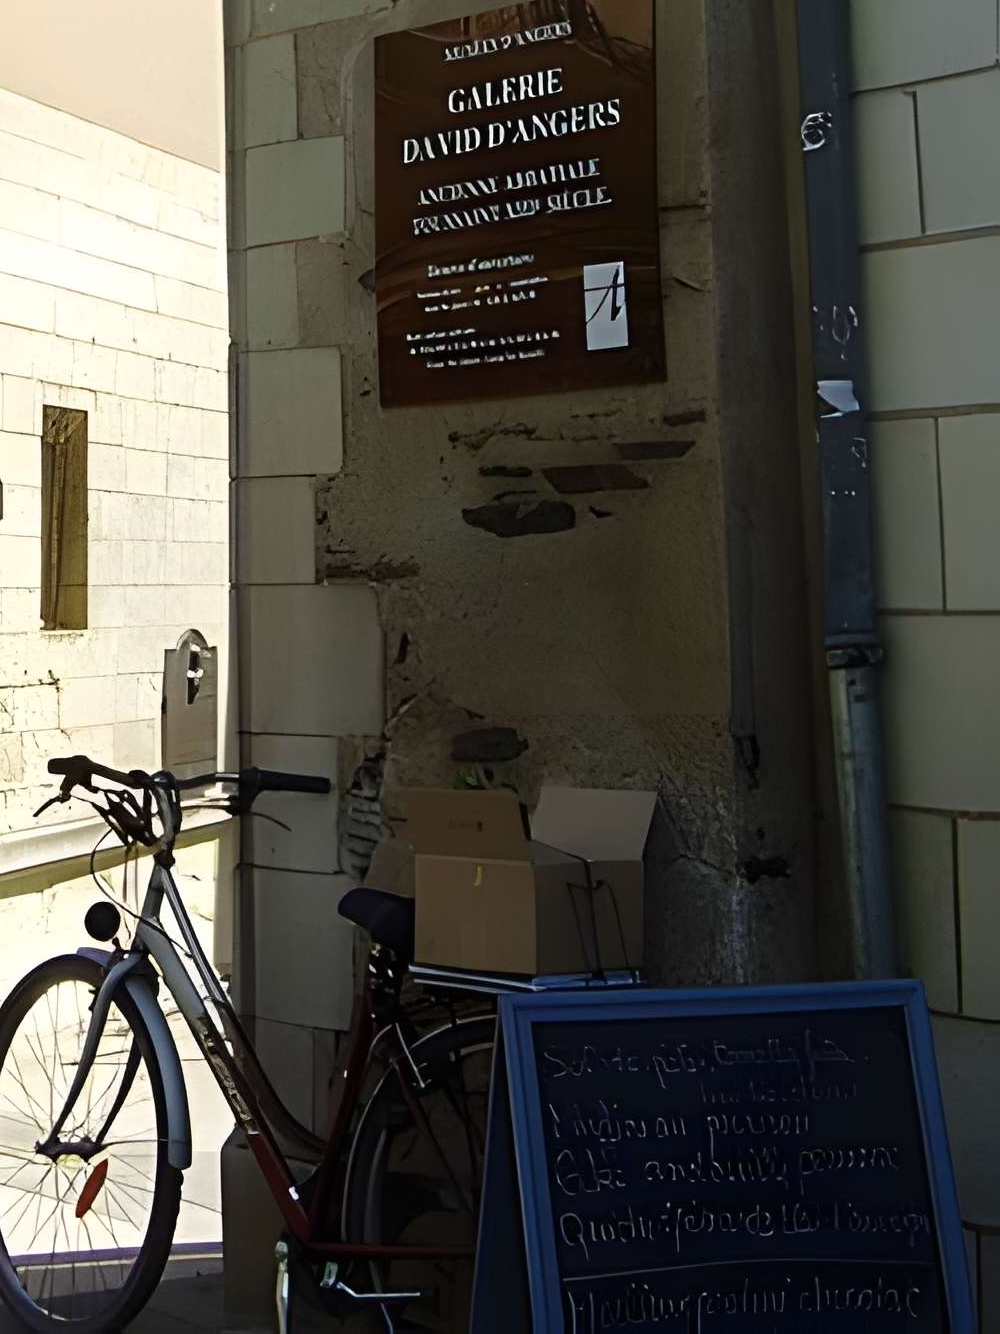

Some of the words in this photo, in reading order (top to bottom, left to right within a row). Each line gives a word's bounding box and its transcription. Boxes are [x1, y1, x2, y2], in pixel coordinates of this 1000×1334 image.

[448, 68, 563, 113] GALERIE
[403, 127, 481, 164] DAVID
[488, 99, 620, 148] D'ANGERS
